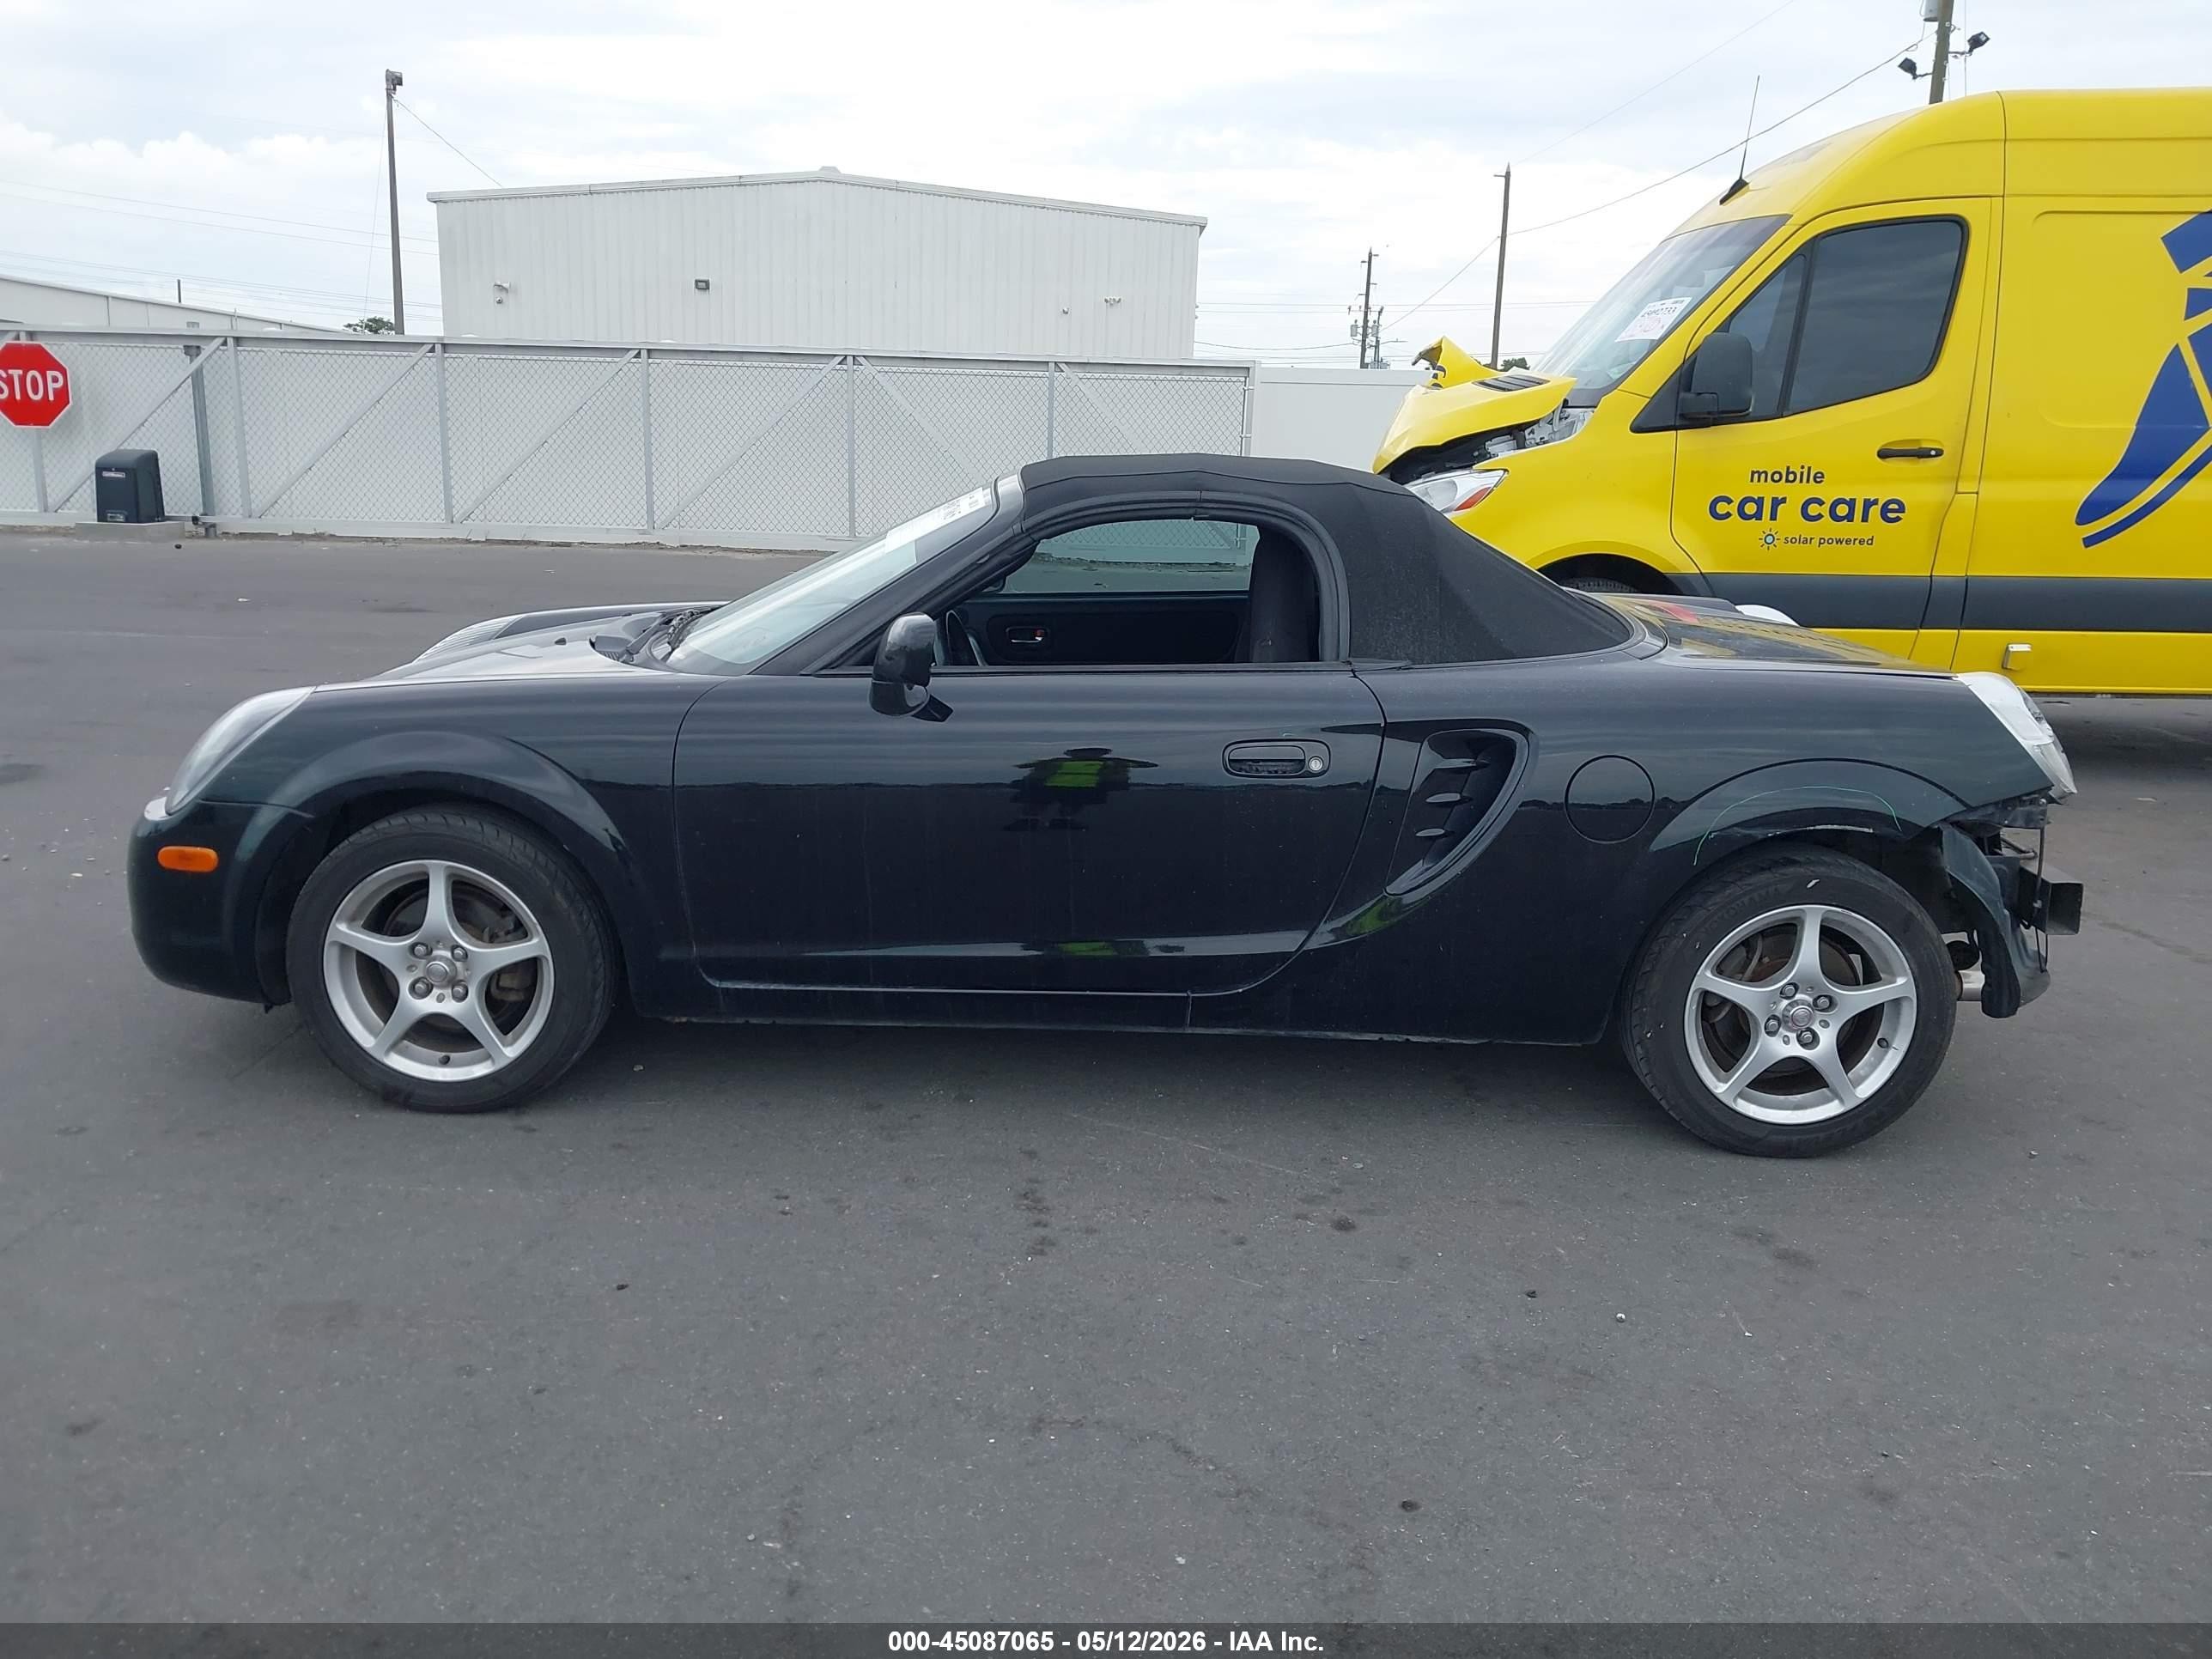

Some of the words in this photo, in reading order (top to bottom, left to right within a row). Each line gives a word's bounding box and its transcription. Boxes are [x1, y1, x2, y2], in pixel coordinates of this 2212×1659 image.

[1749, 465, 1826, 484] mobile
[1708, 495, 1787, 522] car
[1800, 496, 1906, 524] care
[1784, 534, 1815, 545] solar
[1818, 535, 1875, 548] powered
